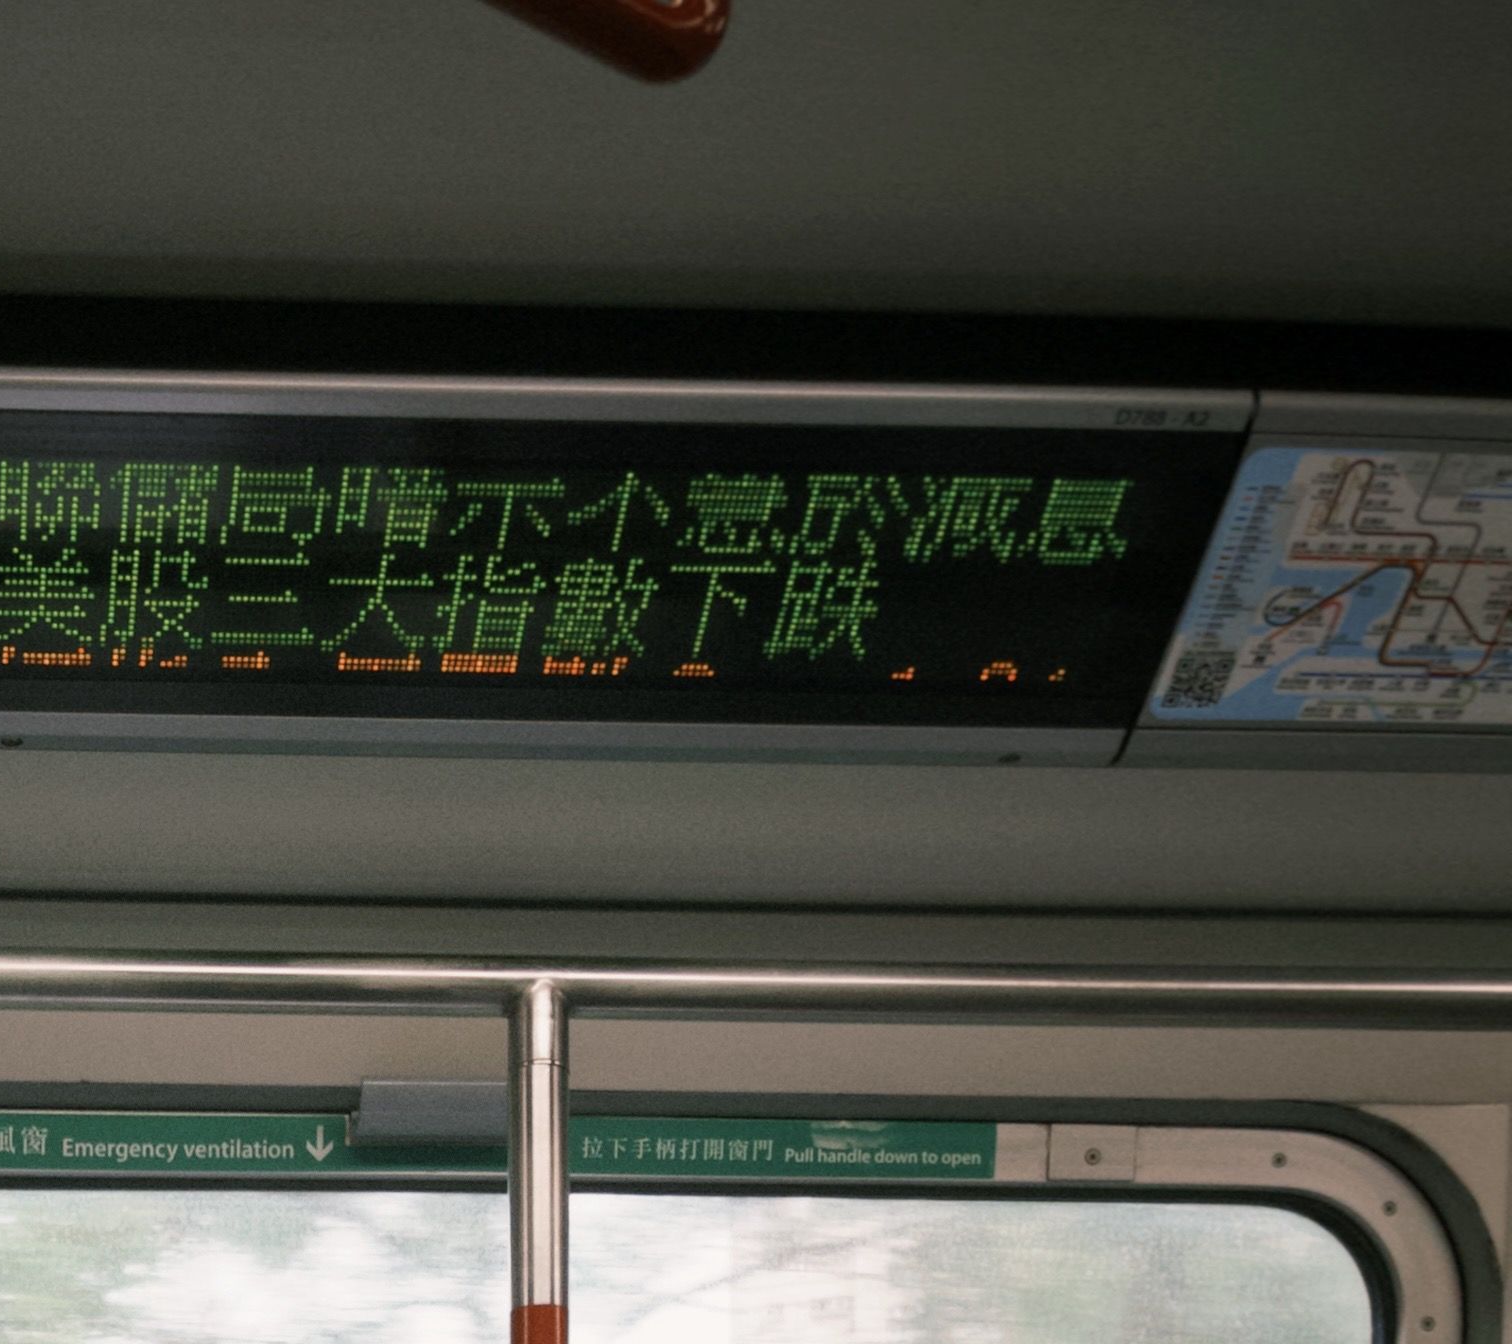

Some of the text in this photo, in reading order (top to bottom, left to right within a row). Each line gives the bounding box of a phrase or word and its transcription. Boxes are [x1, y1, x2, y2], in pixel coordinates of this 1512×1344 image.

[62, 1137, 295, 1162] Emergency ventilation
[581, 1135, 773, 1161] 拉下手柄打開窗門
[784, 1147, 982, 1168] Pull handle down to open
